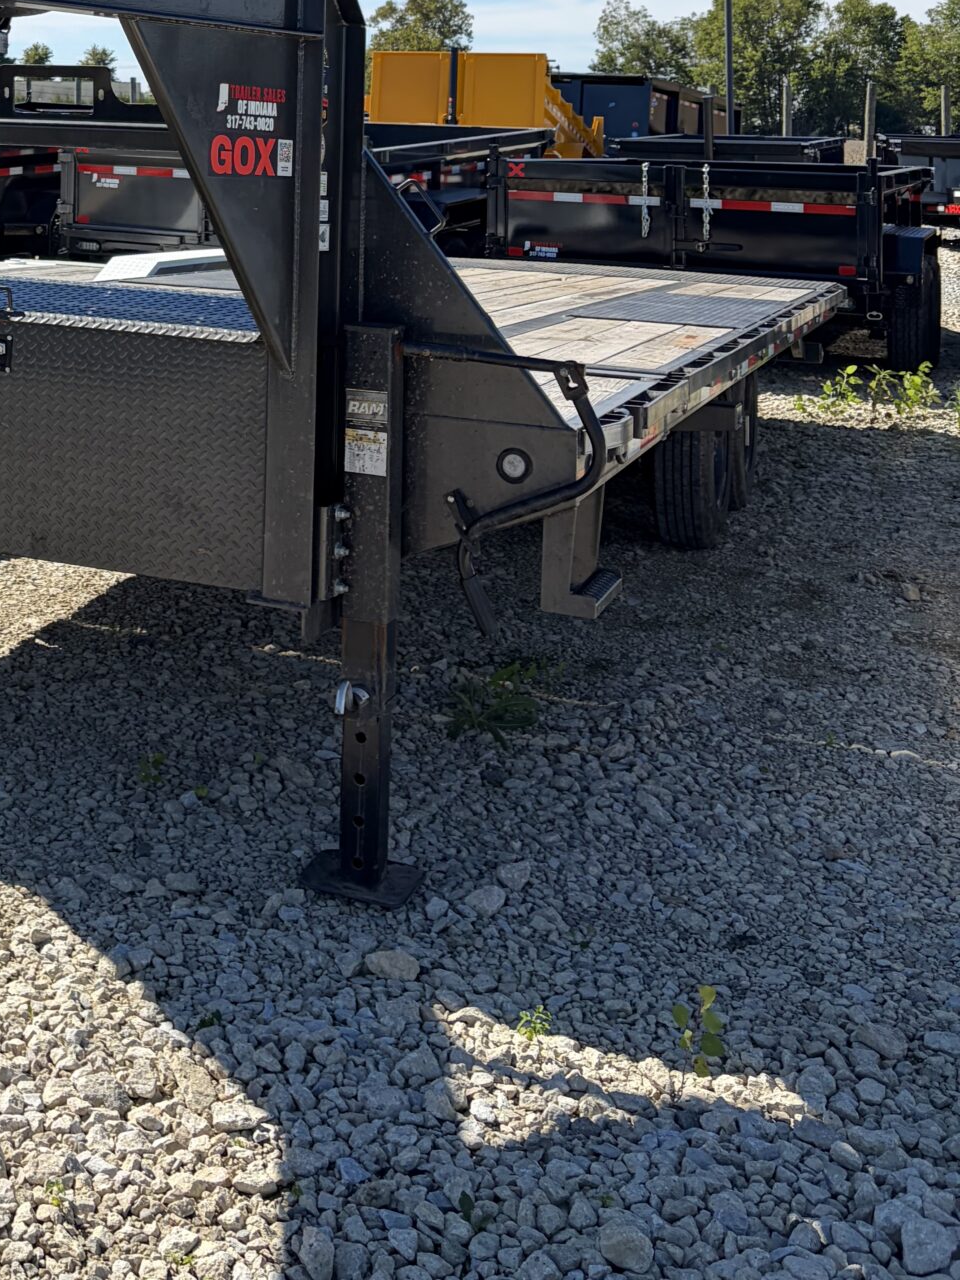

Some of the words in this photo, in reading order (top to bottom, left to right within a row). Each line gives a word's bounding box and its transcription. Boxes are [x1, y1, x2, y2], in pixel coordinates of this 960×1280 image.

[230, 85, 261, 100] TRAILER
[263, 87, 286, 103] SALES
[237, 100, 248, 114] OF
[248, 101, 278, 117] INDIANA
[226, 115, 274, 131] 317-743-0020
[210, 134, 276, 176] GOX
[348, 401, 384, 416] RAM
